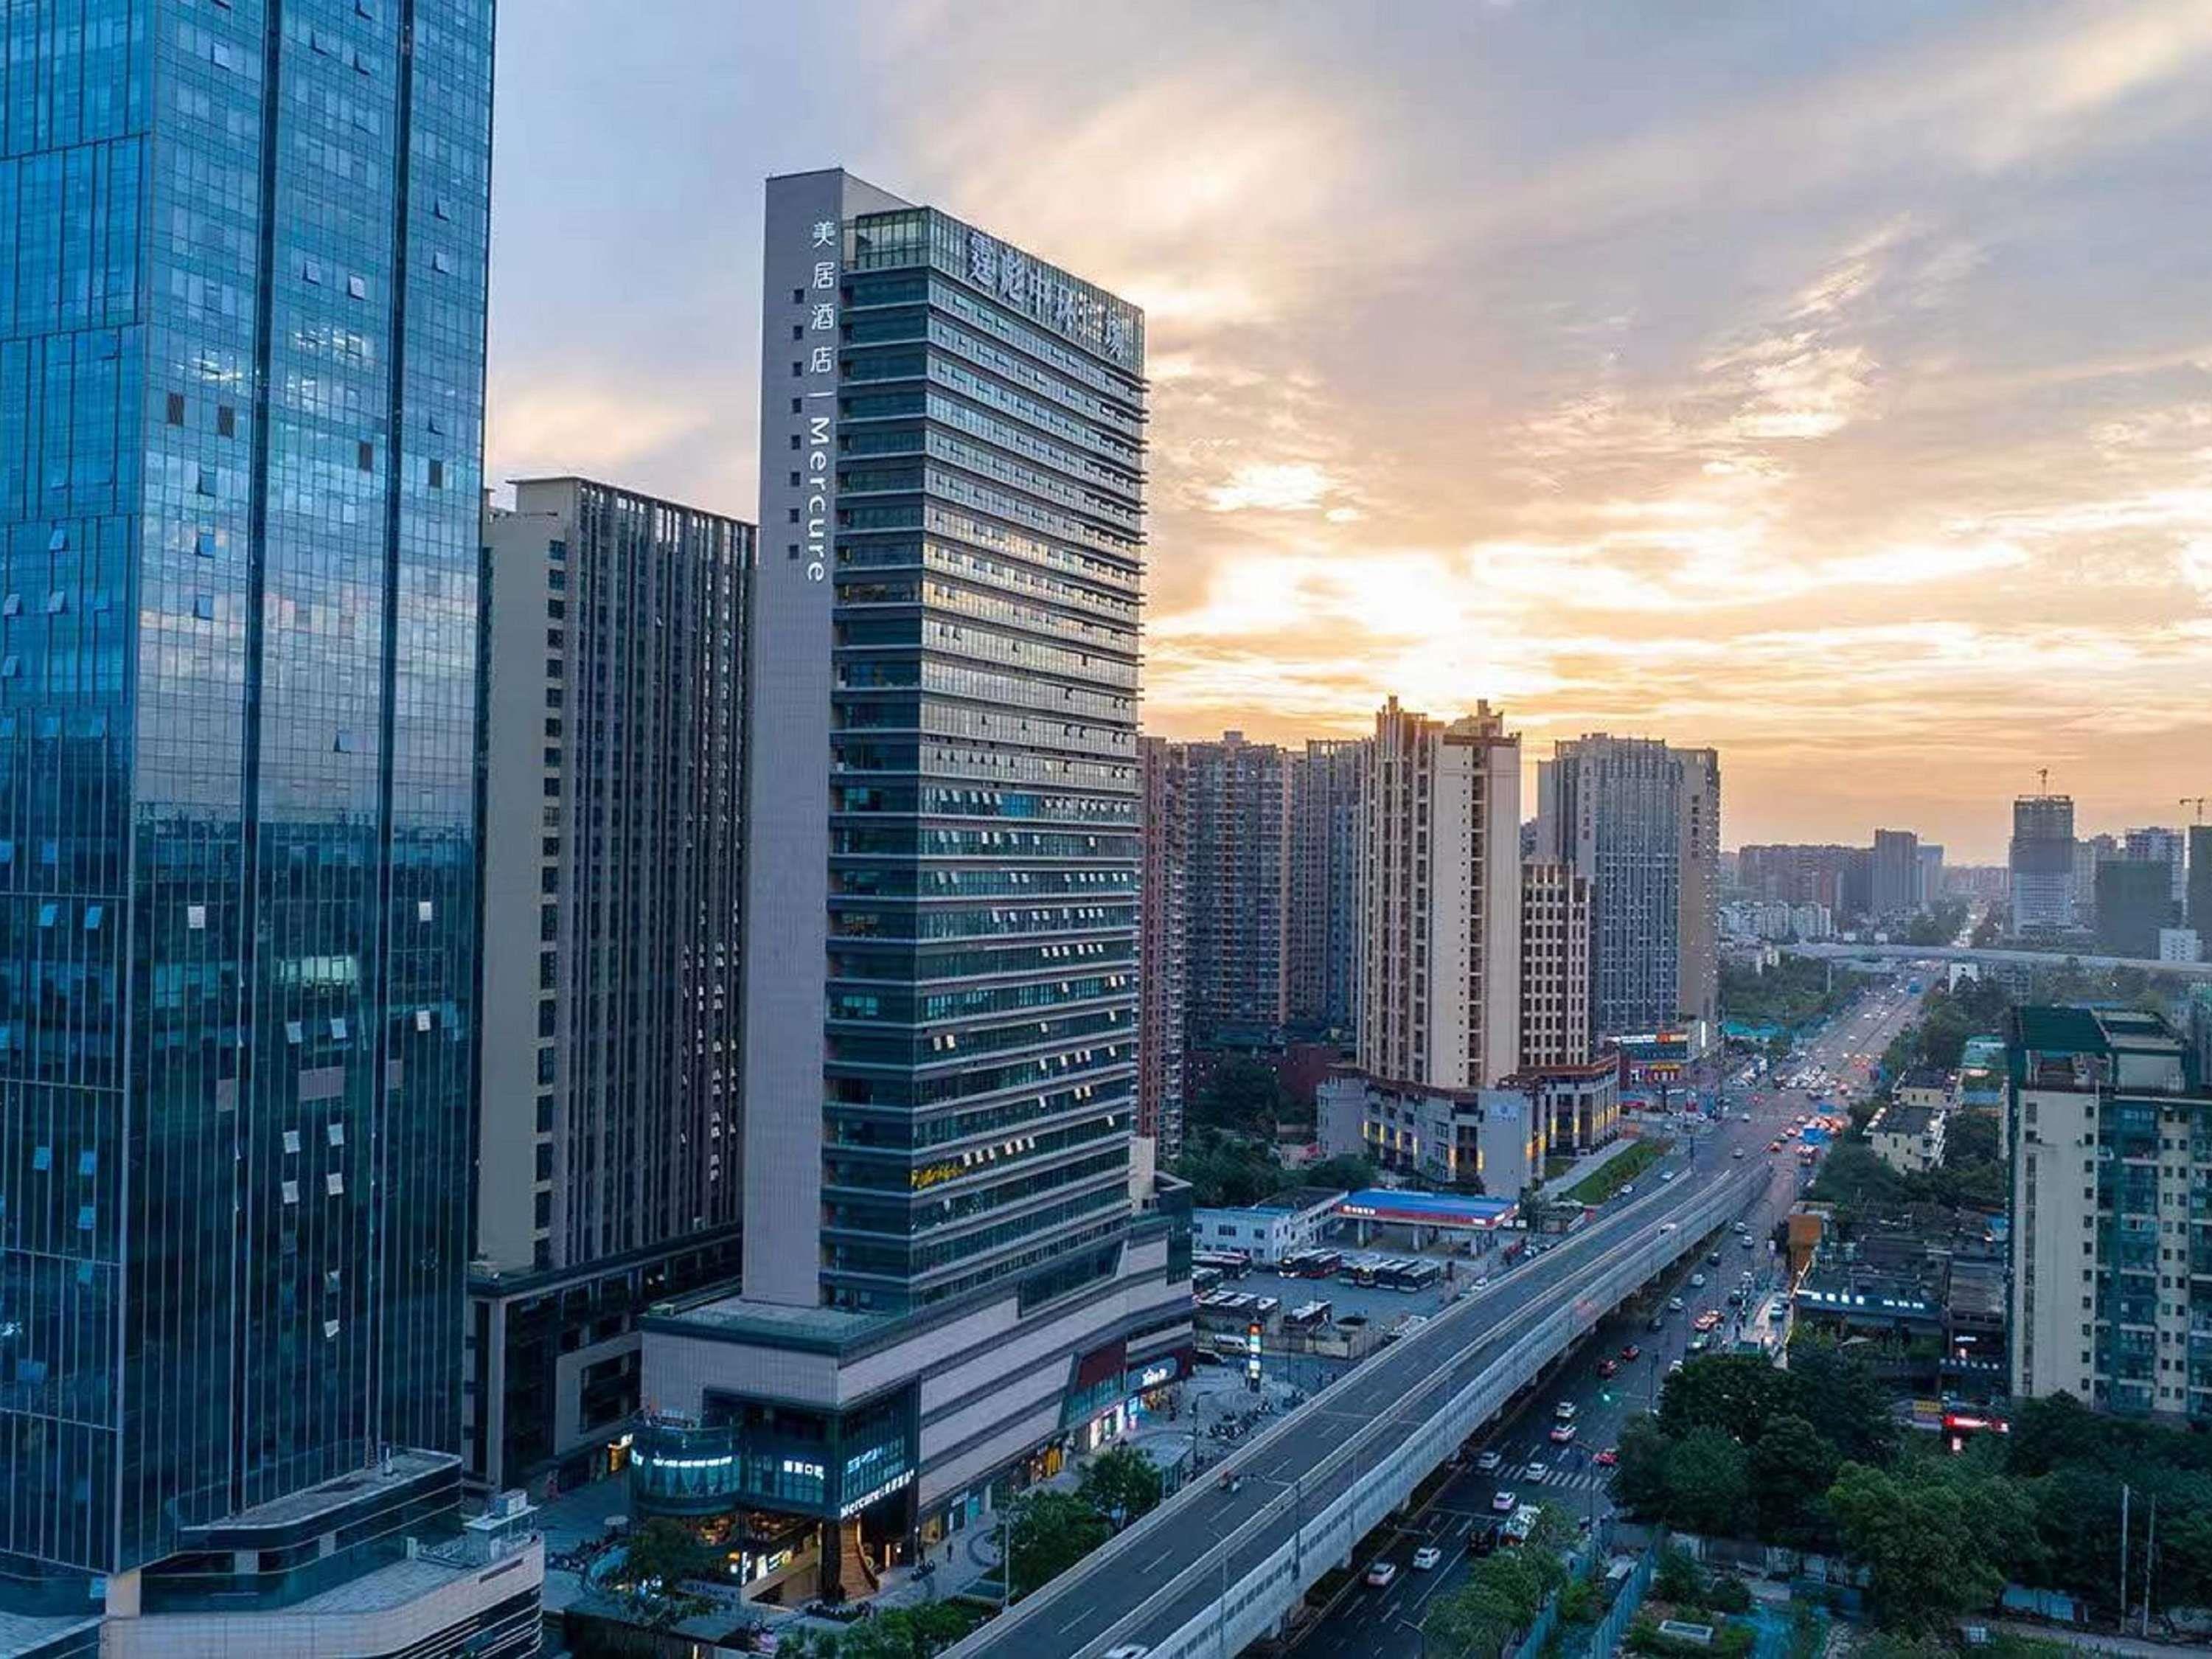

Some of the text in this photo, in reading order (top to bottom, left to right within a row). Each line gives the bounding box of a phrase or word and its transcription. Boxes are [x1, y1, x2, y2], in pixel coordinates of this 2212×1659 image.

[807, 220, 837, 582] 美居酒店 Mercure
